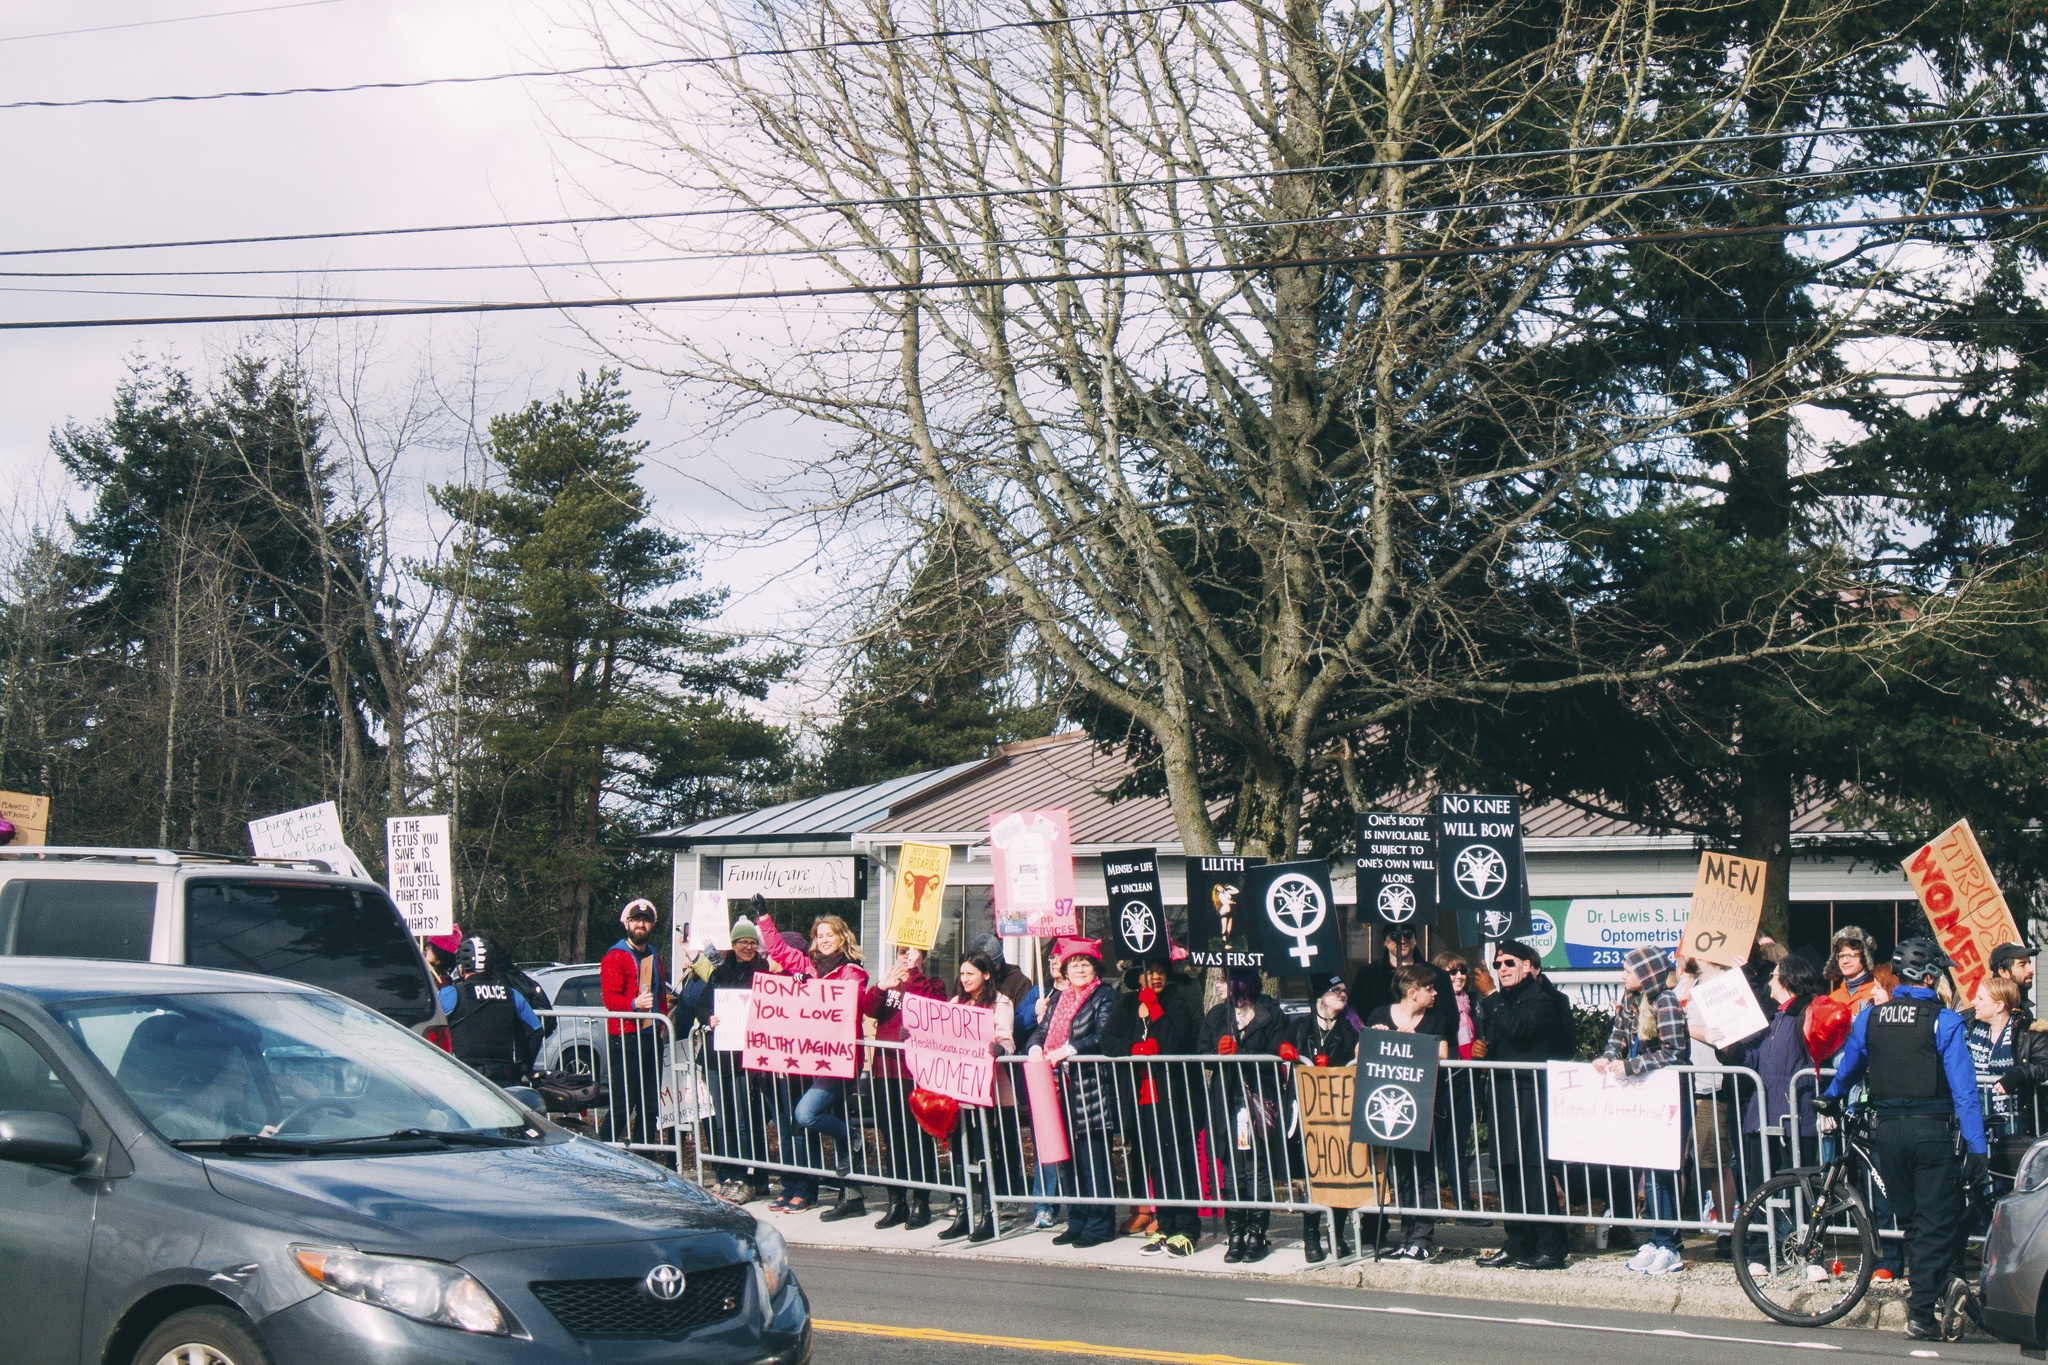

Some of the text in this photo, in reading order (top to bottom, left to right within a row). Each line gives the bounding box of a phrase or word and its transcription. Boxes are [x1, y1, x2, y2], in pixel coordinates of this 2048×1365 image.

[2, 801, 29, 811] PLANNED
[1473, 800, 1511, 814] KNEE
[298, 807, 325, 821] that
[393, 821, 420, 833] IF THE
[1399, 816, 1426, 827] BODY
[270, 822, 327, 848] LOWER
[1364, 830, 1431, 841] IS INVIOLABLE,
[1443, 822, 1514, 838] WILL BOW
[392, 833, 439, 847] FETUS YOU
[395, 847, 430, 860] SAVE IS
[913, 848, 940, 858] KEEP YOUR
[1371, 845, 1424, 856] SUBJECT TO
[394, 861, 434, 874] GAY WILL
[908, 857, 940, 872] ROSARIES
[1140, 862, 1153, 872] LIFE
[1202, 858, 1244, 871] LILITH
[1357, 858, 1435, 870] ONE'S OWN WILL
[398, 875, 440, 888] YOU STILL
[1381, 873, 1415, 884] ALONE.
[1705, 855, 1759, 895] MEN
[789, 885, 816, 895] of Kent
[1121, 882, 1153, 893] UNCLEAN
[1941, 825, 2015, 954] TRUS
[396, 889, 439, 902] FIGHT FOR
[1716, 888, 1740, 904] FOR
[410, 903, 423, 915] ITS
[1588, 909, 1606, 923] Dr.
[1611, 909, 1650, 923] Lewis
[1655, 908, 1668, 923] S.
[1694, 897, 1756, 922] PLANNED
[904, 917, 923, 928] OFF MY
[1041, 916, 1053, 926] PP
[1532, 922, 1551, 931] are
[1910, 845, 1986, 1002] WOMEN
[898, 928, 928, 943] OVARIES
[1028, 925, 1075, 936] SERVICES
[1601, 928, 1683, 945] Optometrist
[1191, 952, 1264, 966] WAS FIRST
[474, 985, 507, 1000] POLICE
[754, 975, 845, 1003] HONK IF
[887, 990, 901, 999] THE
[754, 999, 844, 1022] YOU LOVE
[1879, 1005, 1917, 1023] POLICE
[906, 998, 985, 1041] SUPPORT
[747, 1031, 854, 1060] HEALTHY VAGINAS
[1380, 1041, 1413, 1059] HAIL
[972, 1047, 985, 1059] all
[915, 1053, 986, 1098] WOMEN
[1366, 1062, 1424, 1083] THYSELF
[1559, 1069, 1583, 1090] I
[1301, 1072, 1356, 1117] DEFE
[1554, 1096, 1598, 1117] Planned
[724, 1296, 736, 1310] S
